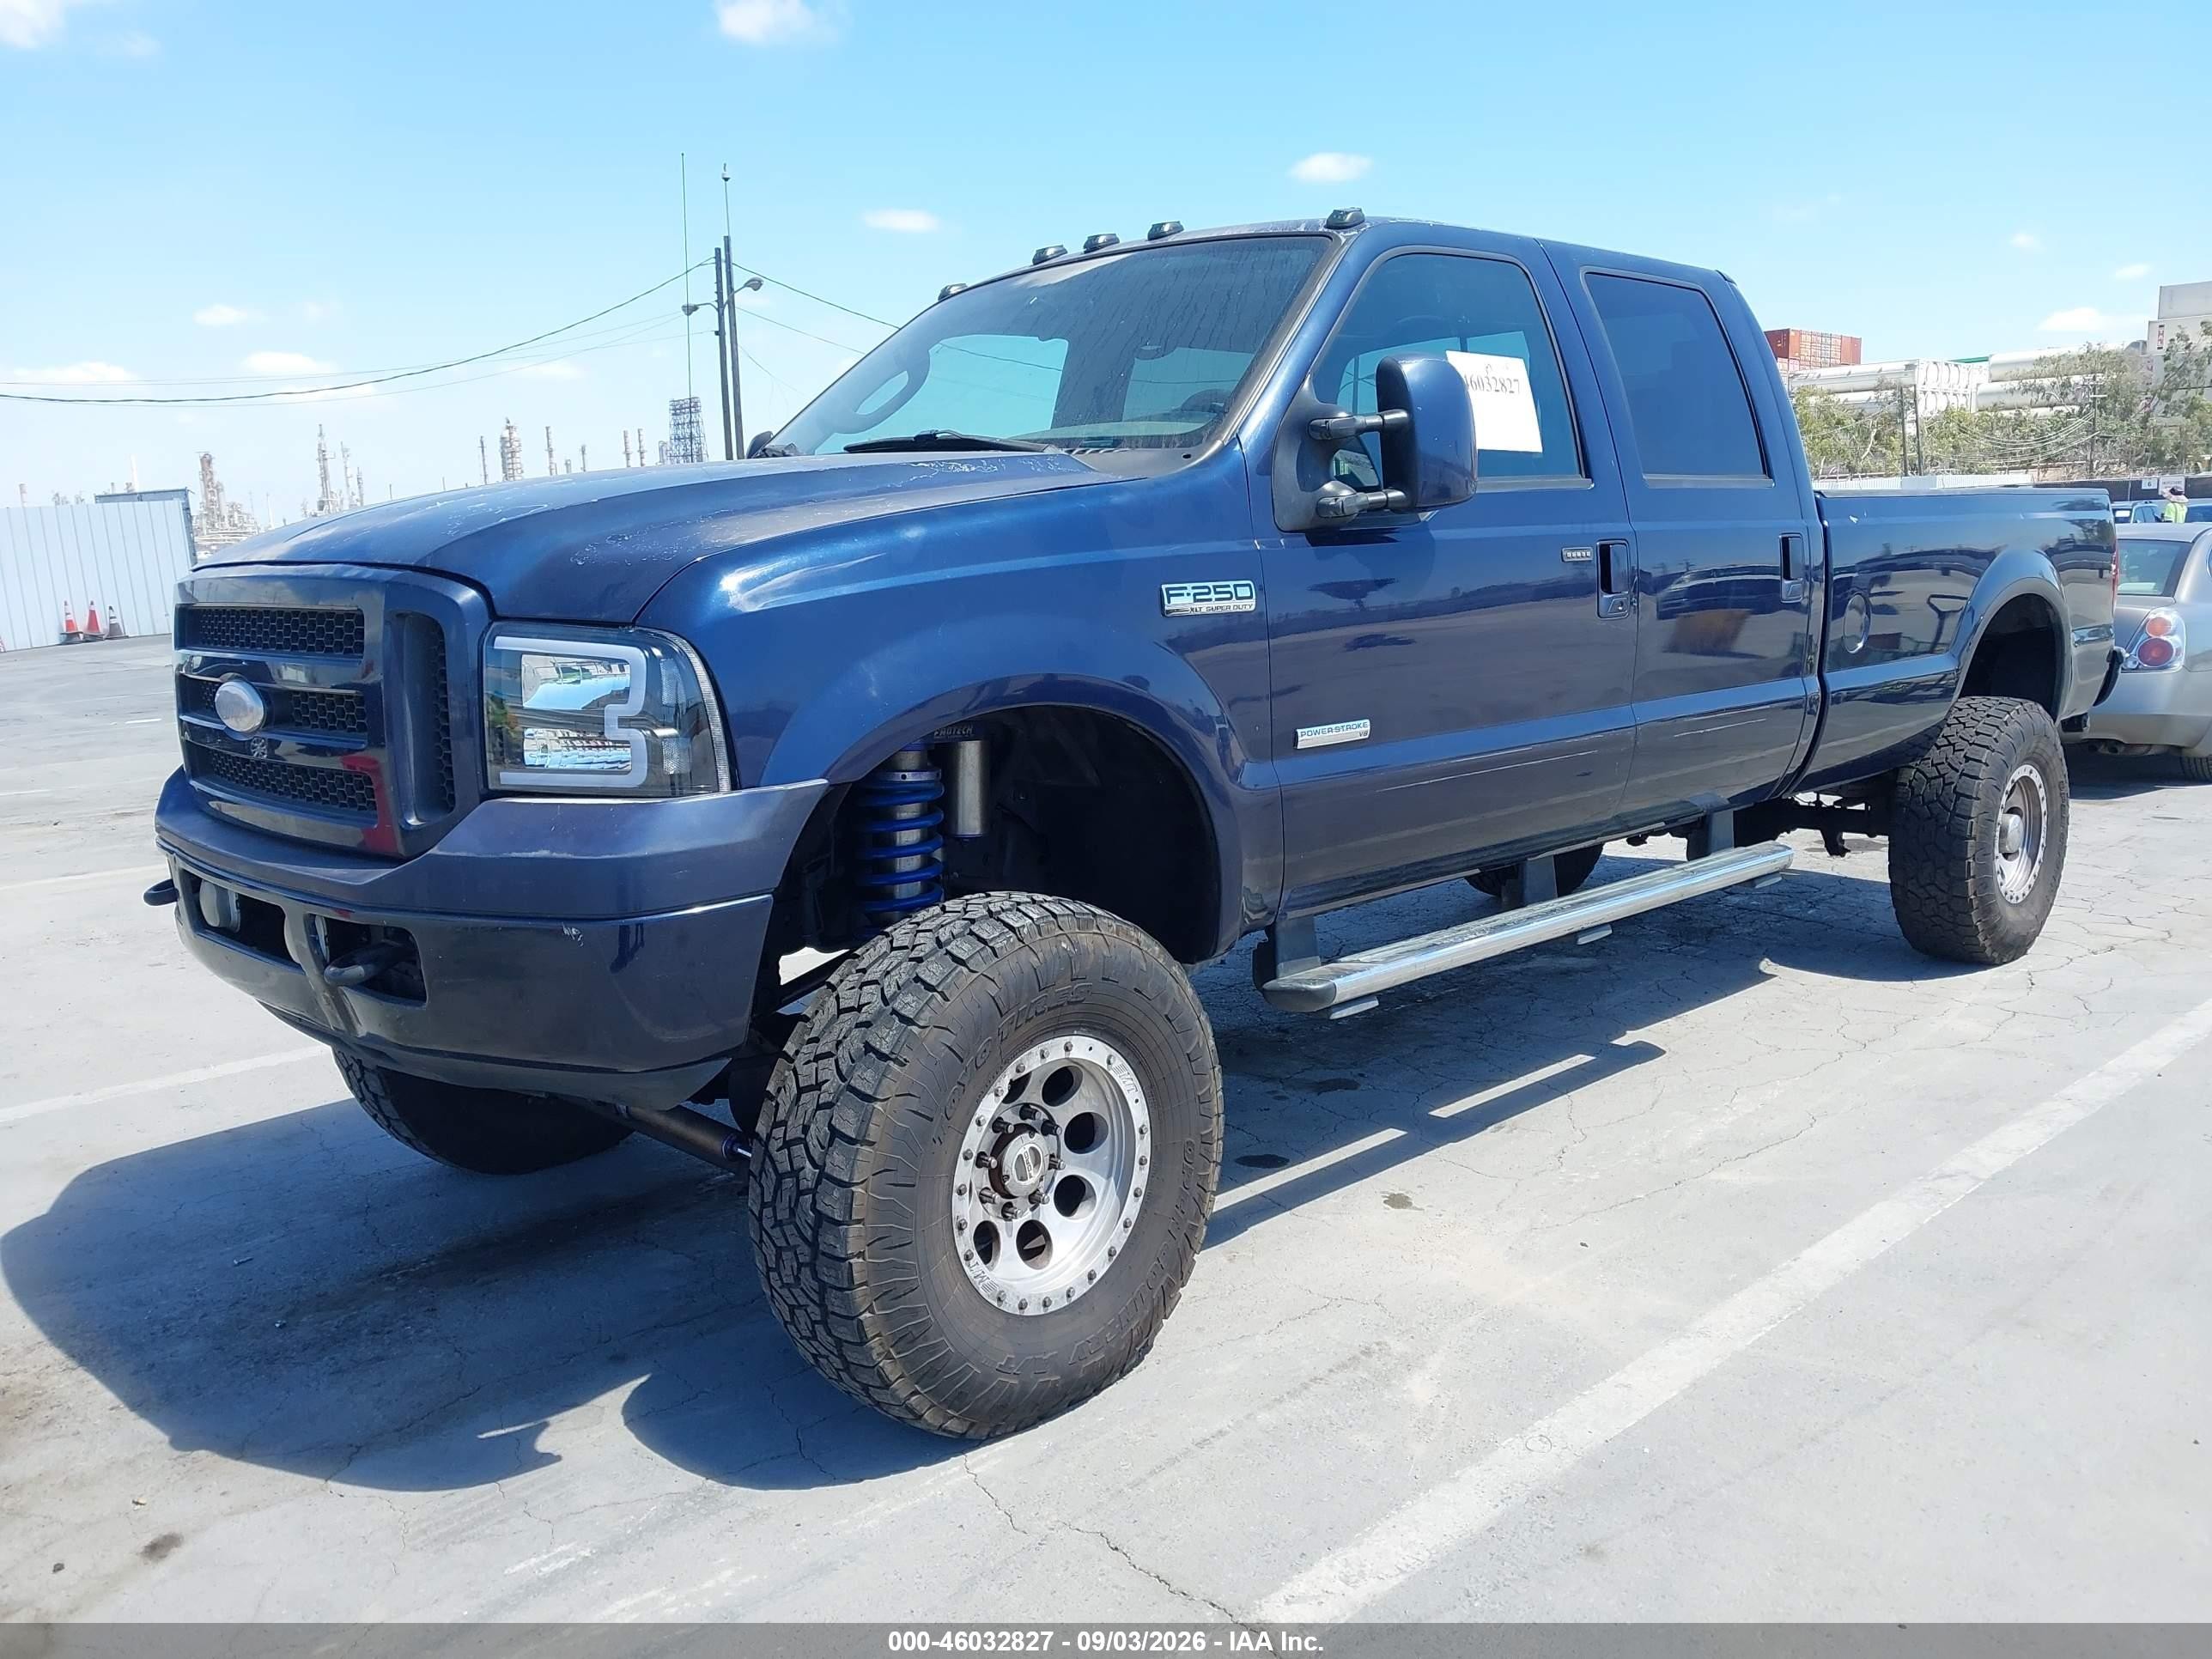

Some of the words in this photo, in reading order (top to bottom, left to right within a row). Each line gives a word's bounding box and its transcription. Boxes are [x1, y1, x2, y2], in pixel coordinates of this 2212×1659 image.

[1206, 604, 1231, 612] SUPER
[997, 982, 1093, 1042] TIRES
[1168, 1139, 1196, 1241] OPEN
